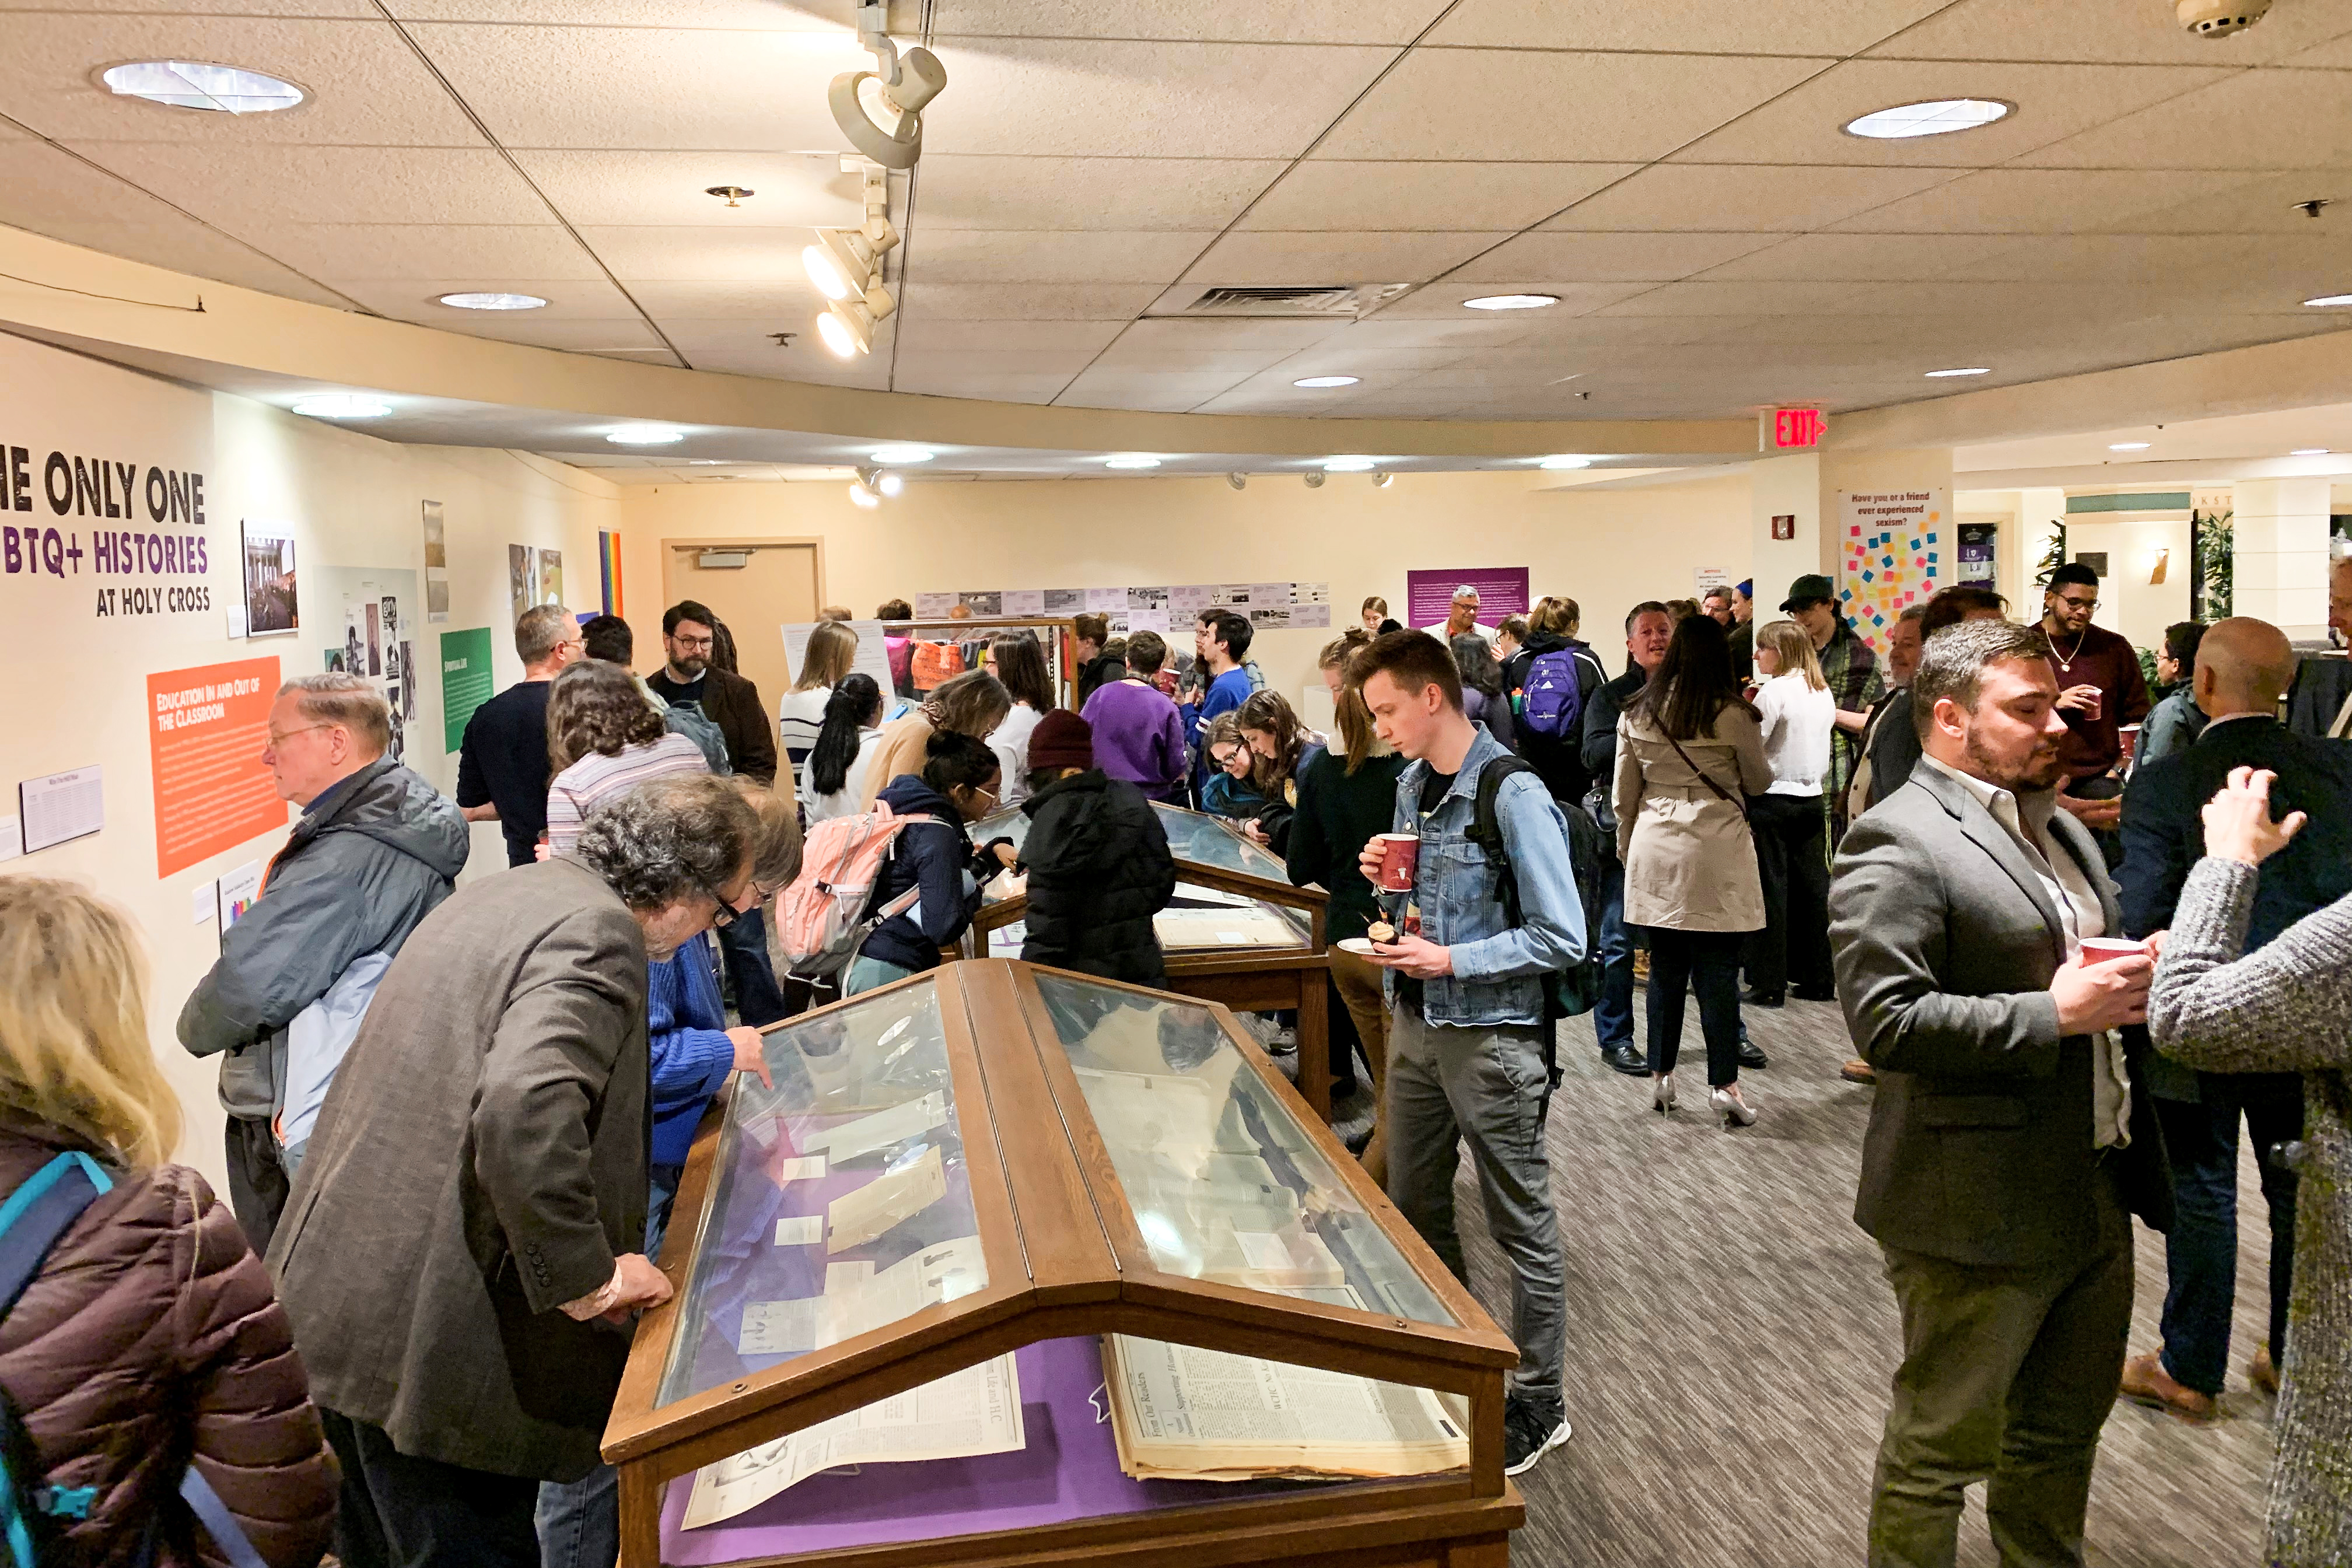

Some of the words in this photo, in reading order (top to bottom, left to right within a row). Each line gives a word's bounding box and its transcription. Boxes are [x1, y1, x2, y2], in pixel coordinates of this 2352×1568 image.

[1776, 410, 1820, 447] EXIT
[44, 451, 136, 519] ONLY
[146, 466, 205, 524] ONE
[1852, 494, 1871, 502] Have
[1874, 495, 1888, 504] you
[1906, 492, 1930, 501] friend
[1876, 517, 1908, 526] sexism?
[1877, 505, 1924, 516] experienced
[0, 526, 83, 579] BTQ+
[93, 531, 208, 574] HISTORIES
[96, 589, 116, 617] AT
[121, 587, 162, 615] HOLY
[169, 586, 210, 613] CROSS
[156, 688, 204, 712] EDUCATION
[206, 684, 215, 702] IN
[217, 682, 233, 699] AND
[234, 678, 250, 696] OUT
[251, 677, 260, 692] OF
[158, 713, 174, 732] THE
[176, 702, 225, 727] CLASSROOM
[1138, 1372, 1152, 1403] Readers
[1171, 1375, 1186, 1410] Supporting
[1144, 1405, 1156, 1418] Our
[1151, 1420, 1163, 1437] From
